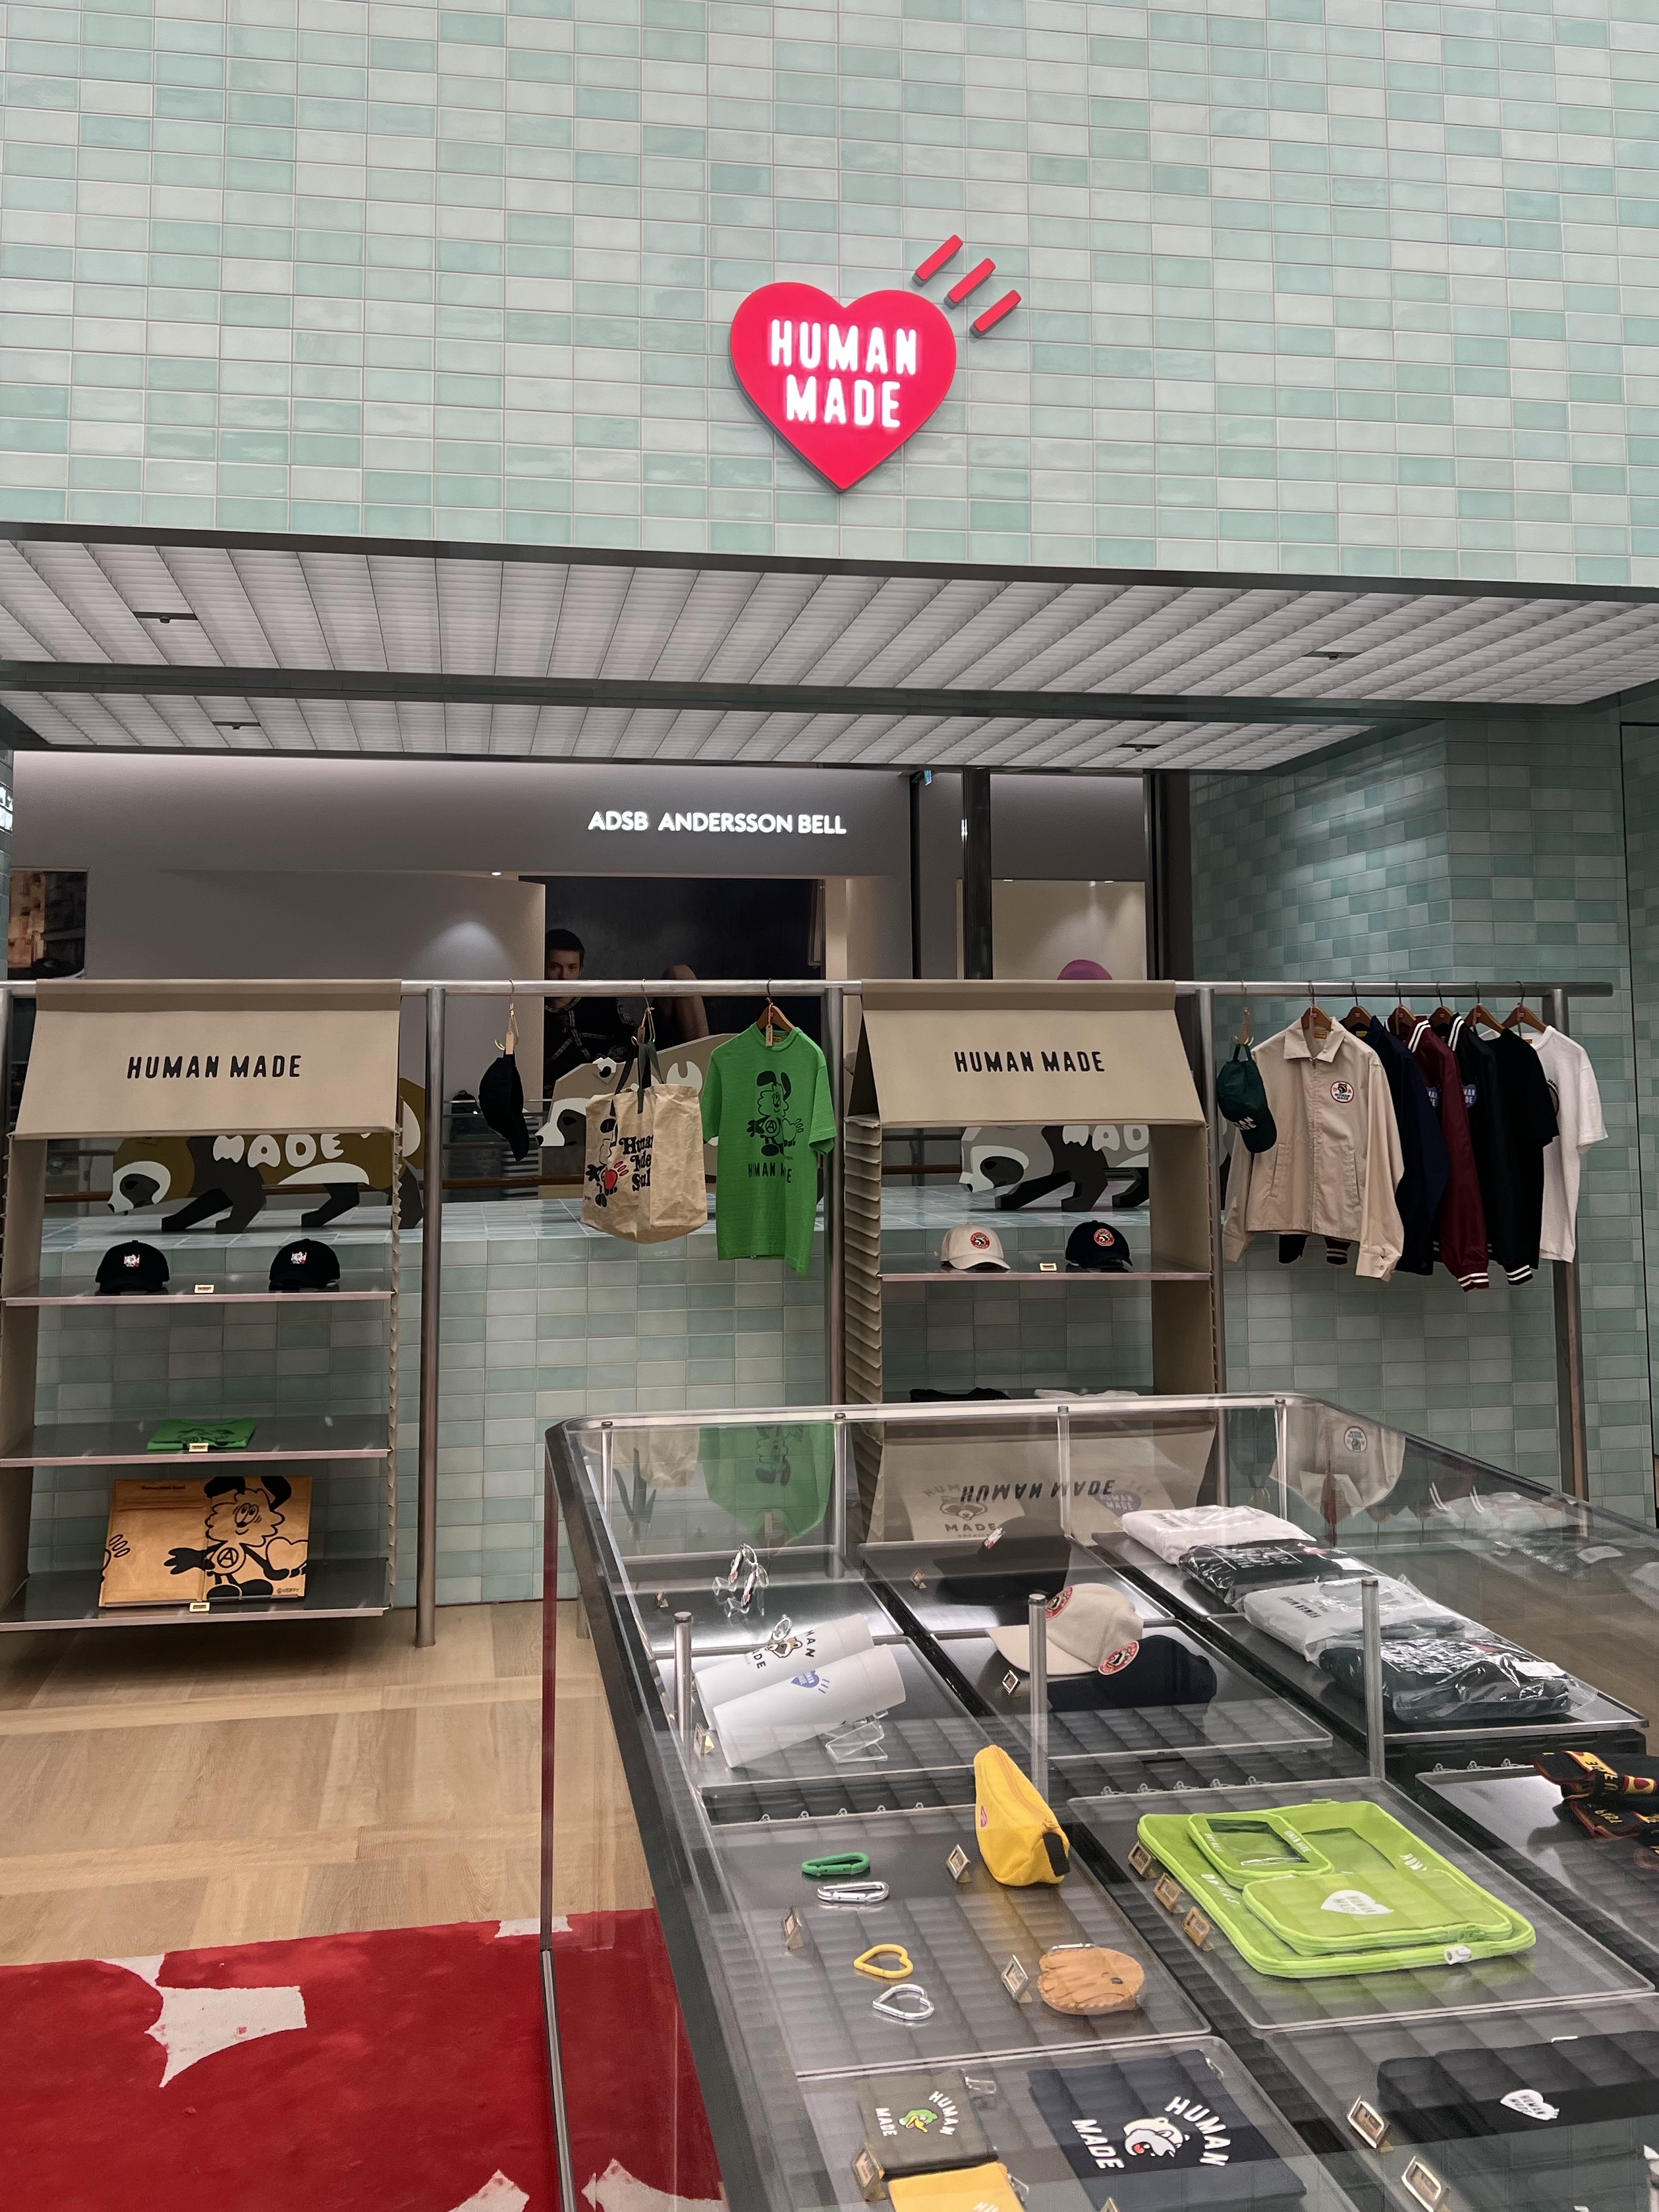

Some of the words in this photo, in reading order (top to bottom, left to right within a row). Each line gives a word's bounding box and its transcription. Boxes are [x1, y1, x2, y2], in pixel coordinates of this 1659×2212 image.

[769, 318, 918, 376] HUMAN
[785, 374, 901, 428] MADE
[588, 810, 649, 831] ADSB
[658, 812, 793, 834] ANDERSSON
[797, 814, 847, 834] BELL
[127, 1055, 219, 1079] HUMAN
[229, 1054, 302, 1078] MADE
[953, 1051, 1035, 1073] HUMAN
[1040, 1051, 1106, 1073] MADE
[213, 1133, 344, 1168] MADE
[944, 1523, 996, 1533] MADE
[875, 2107, 898, 2137] MADE
[928, 2090, 959, 2136] HUMAN
[1071, 2118, 1125, 2169] MADE
[1164, 2095, 1231, 2167] HUMAN
